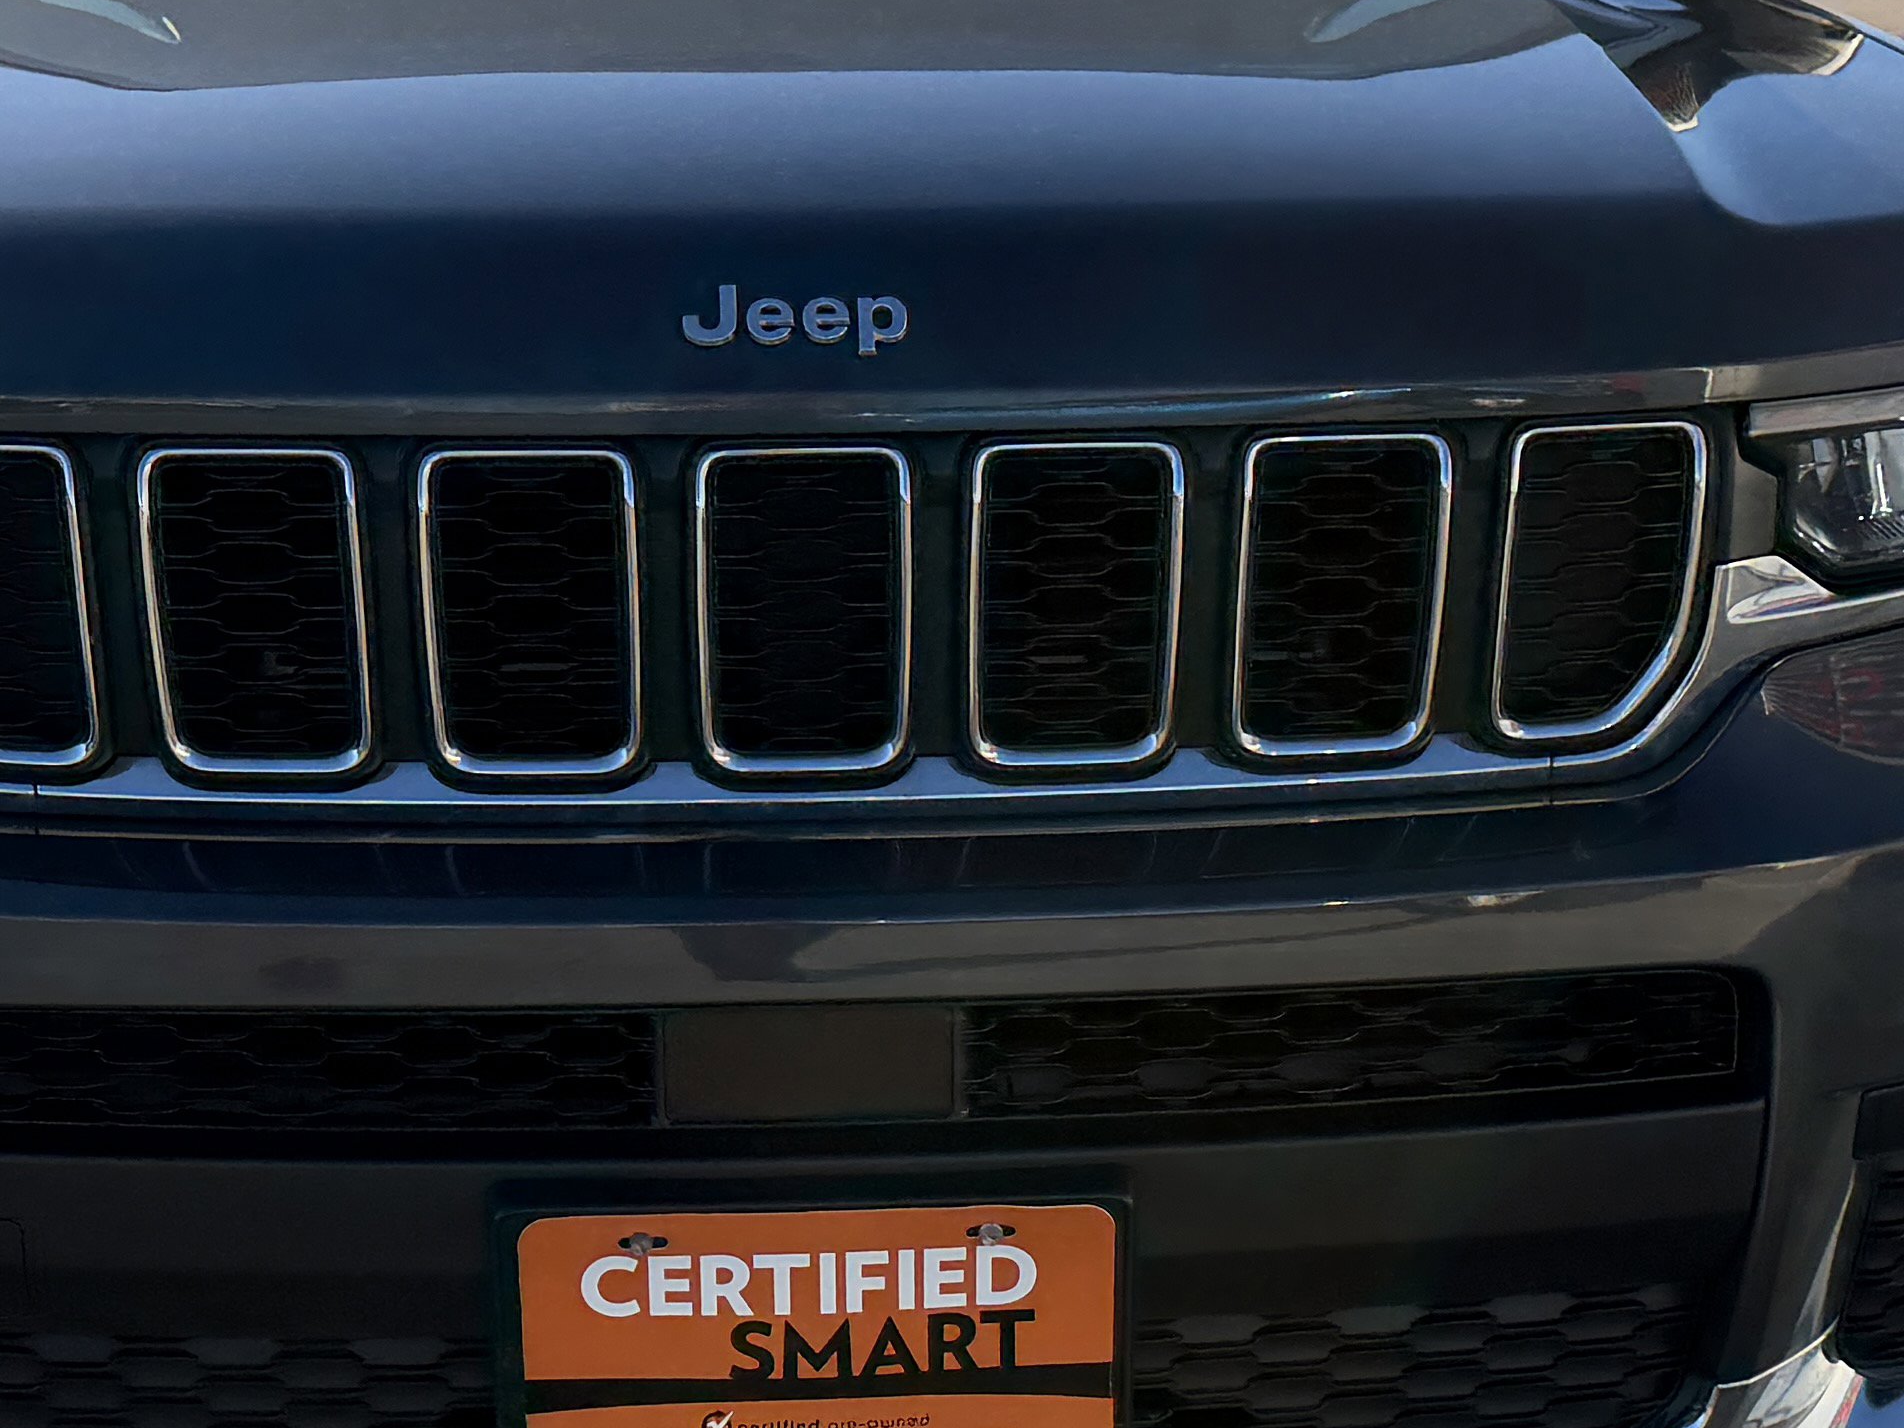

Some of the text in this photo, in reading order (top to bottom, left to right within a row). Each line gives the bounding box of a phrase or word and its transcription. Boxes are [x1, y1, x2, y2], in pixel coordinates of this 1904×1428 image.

[682, 284, 908, 356] Jeep
[580, 1244, 1038, 1318] CERTIFIED
[729, 1309, 1036, 1380] SMART
